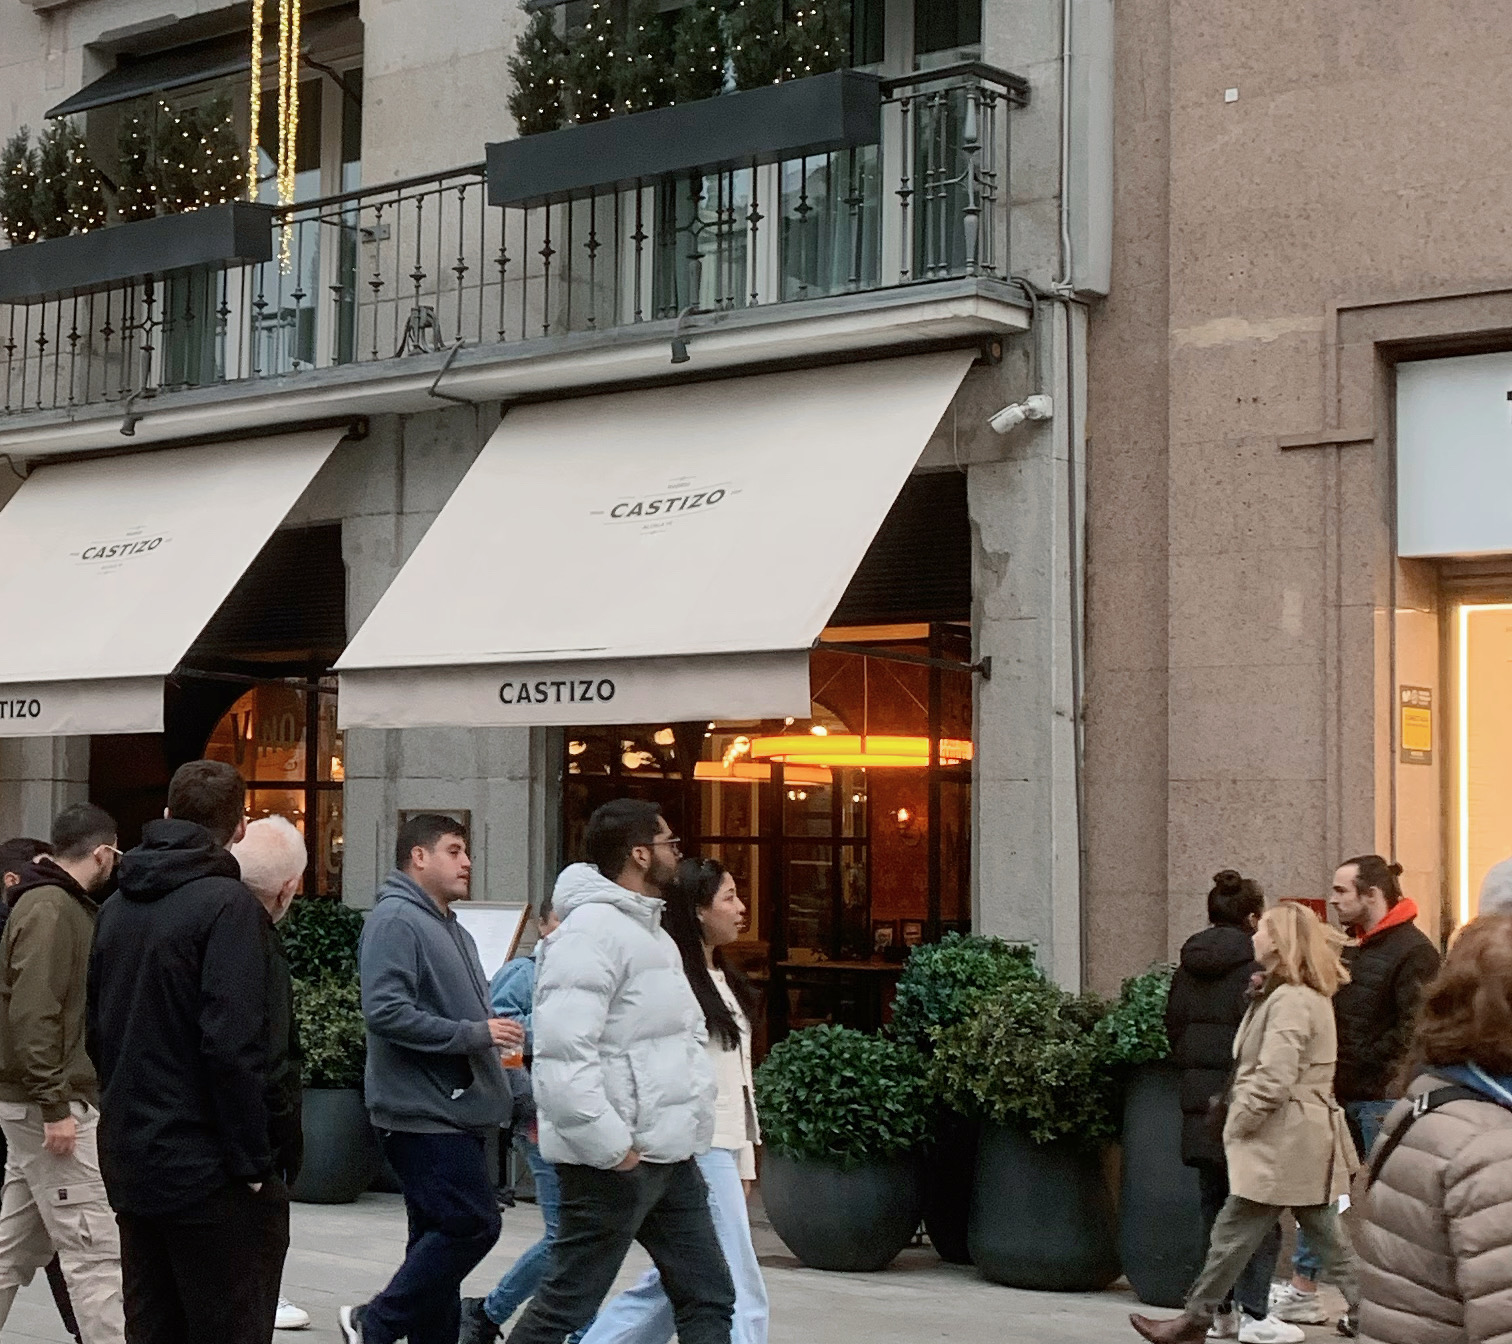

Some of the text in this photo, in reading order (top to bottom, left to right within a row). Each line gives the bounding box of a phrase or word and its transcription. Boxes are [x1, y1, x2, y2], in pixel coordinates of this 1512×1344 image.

[610, 488, 726, 519] CASTIZO
[81, 537, 163, 560] CASTIZO
[499, 678, 616, 704] CASTIZO
